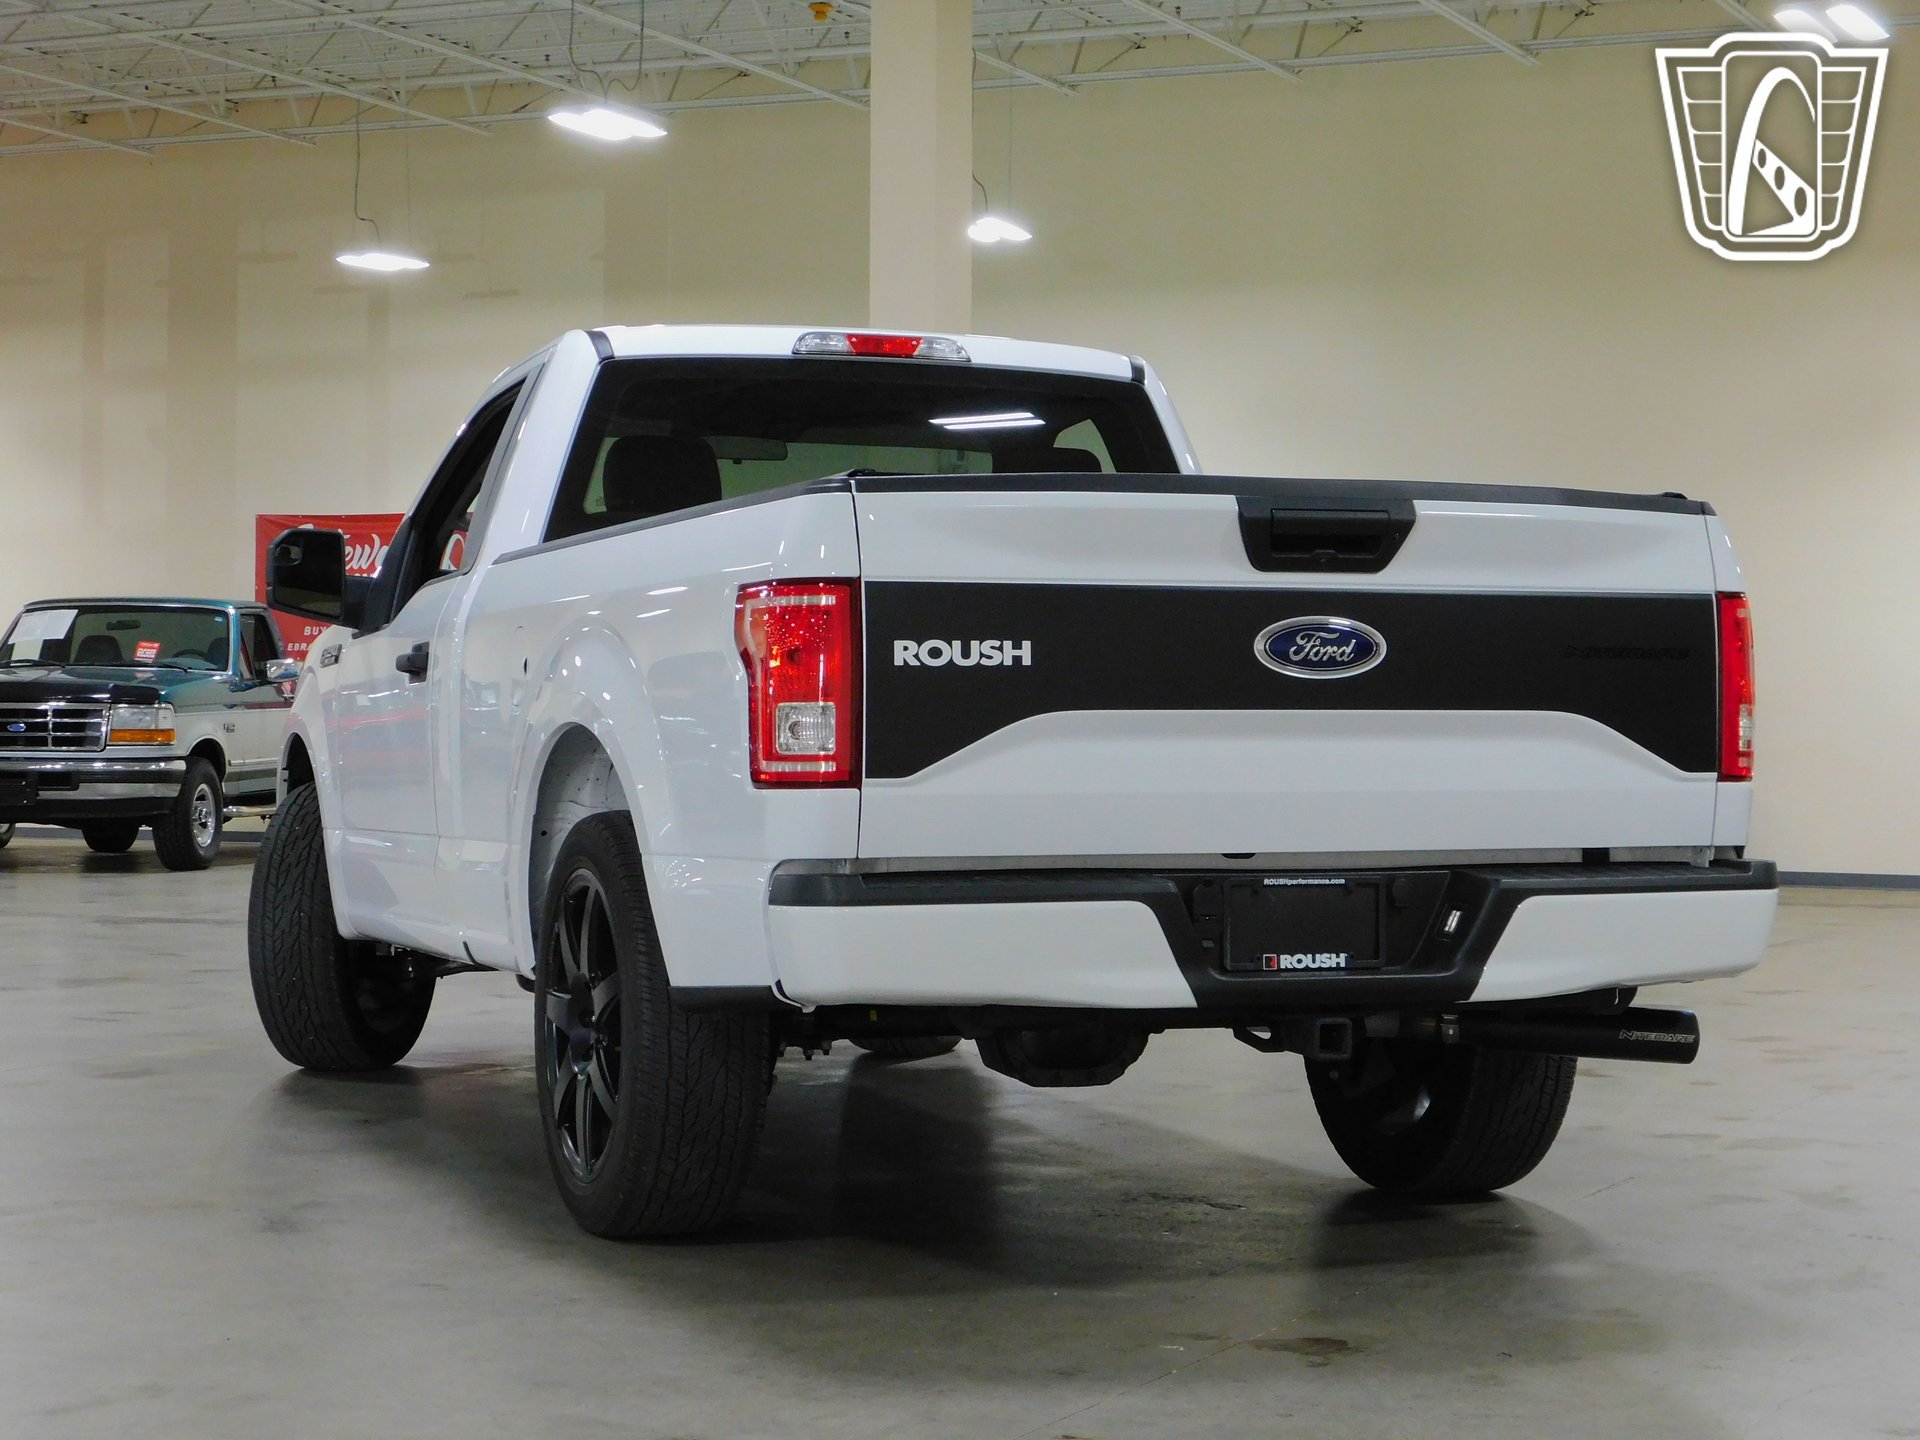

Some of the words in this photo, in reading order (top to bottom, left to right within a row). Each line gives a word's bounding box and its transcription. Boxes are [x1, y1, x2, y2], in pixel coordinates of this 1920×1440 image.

[893, 639, 1032, 667] ROUSH
[1288, 630, 1357, 662] Ford
[1279, 952, 1346, 969] ROUSH
